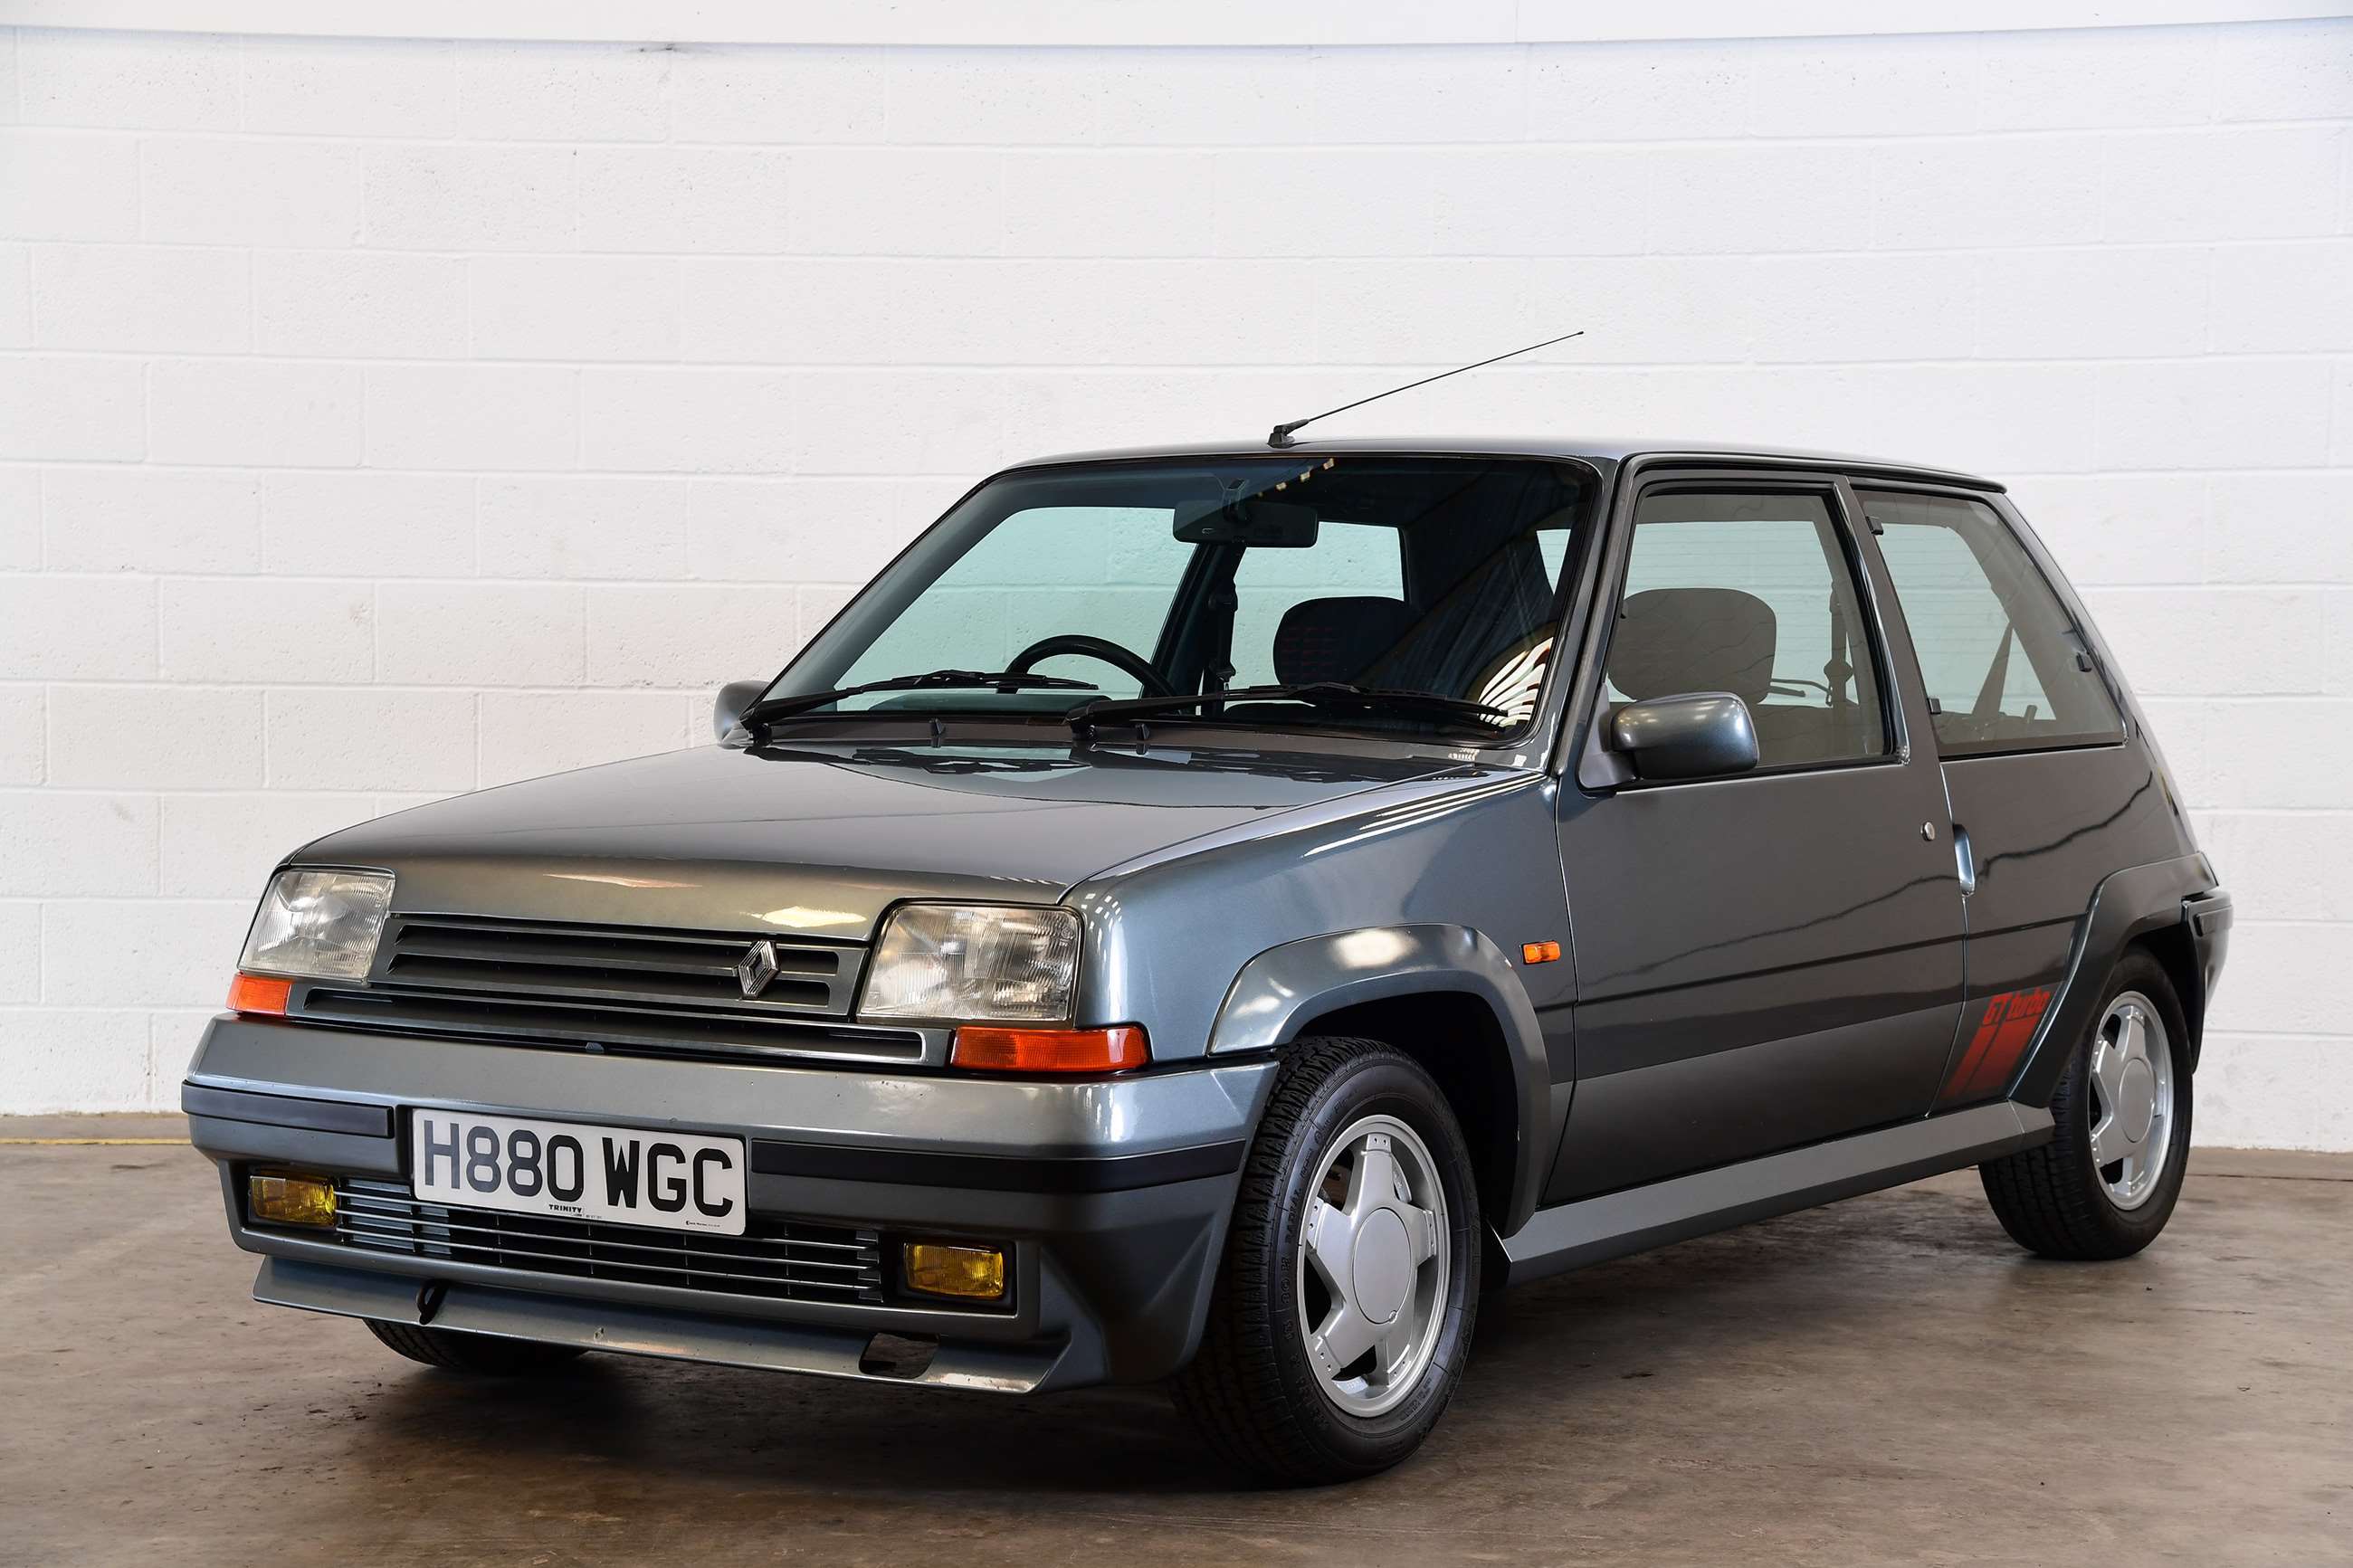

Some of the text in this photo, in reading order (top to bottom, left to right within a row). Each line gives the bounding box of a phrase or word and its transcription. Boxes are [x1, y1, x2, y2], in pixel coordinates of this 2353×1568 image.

[1983, 992, 2014, 1025] GT
[424, 1119, 734, 1218] H880 WGC
[548, 1203, 582, 1213] TRINITY
